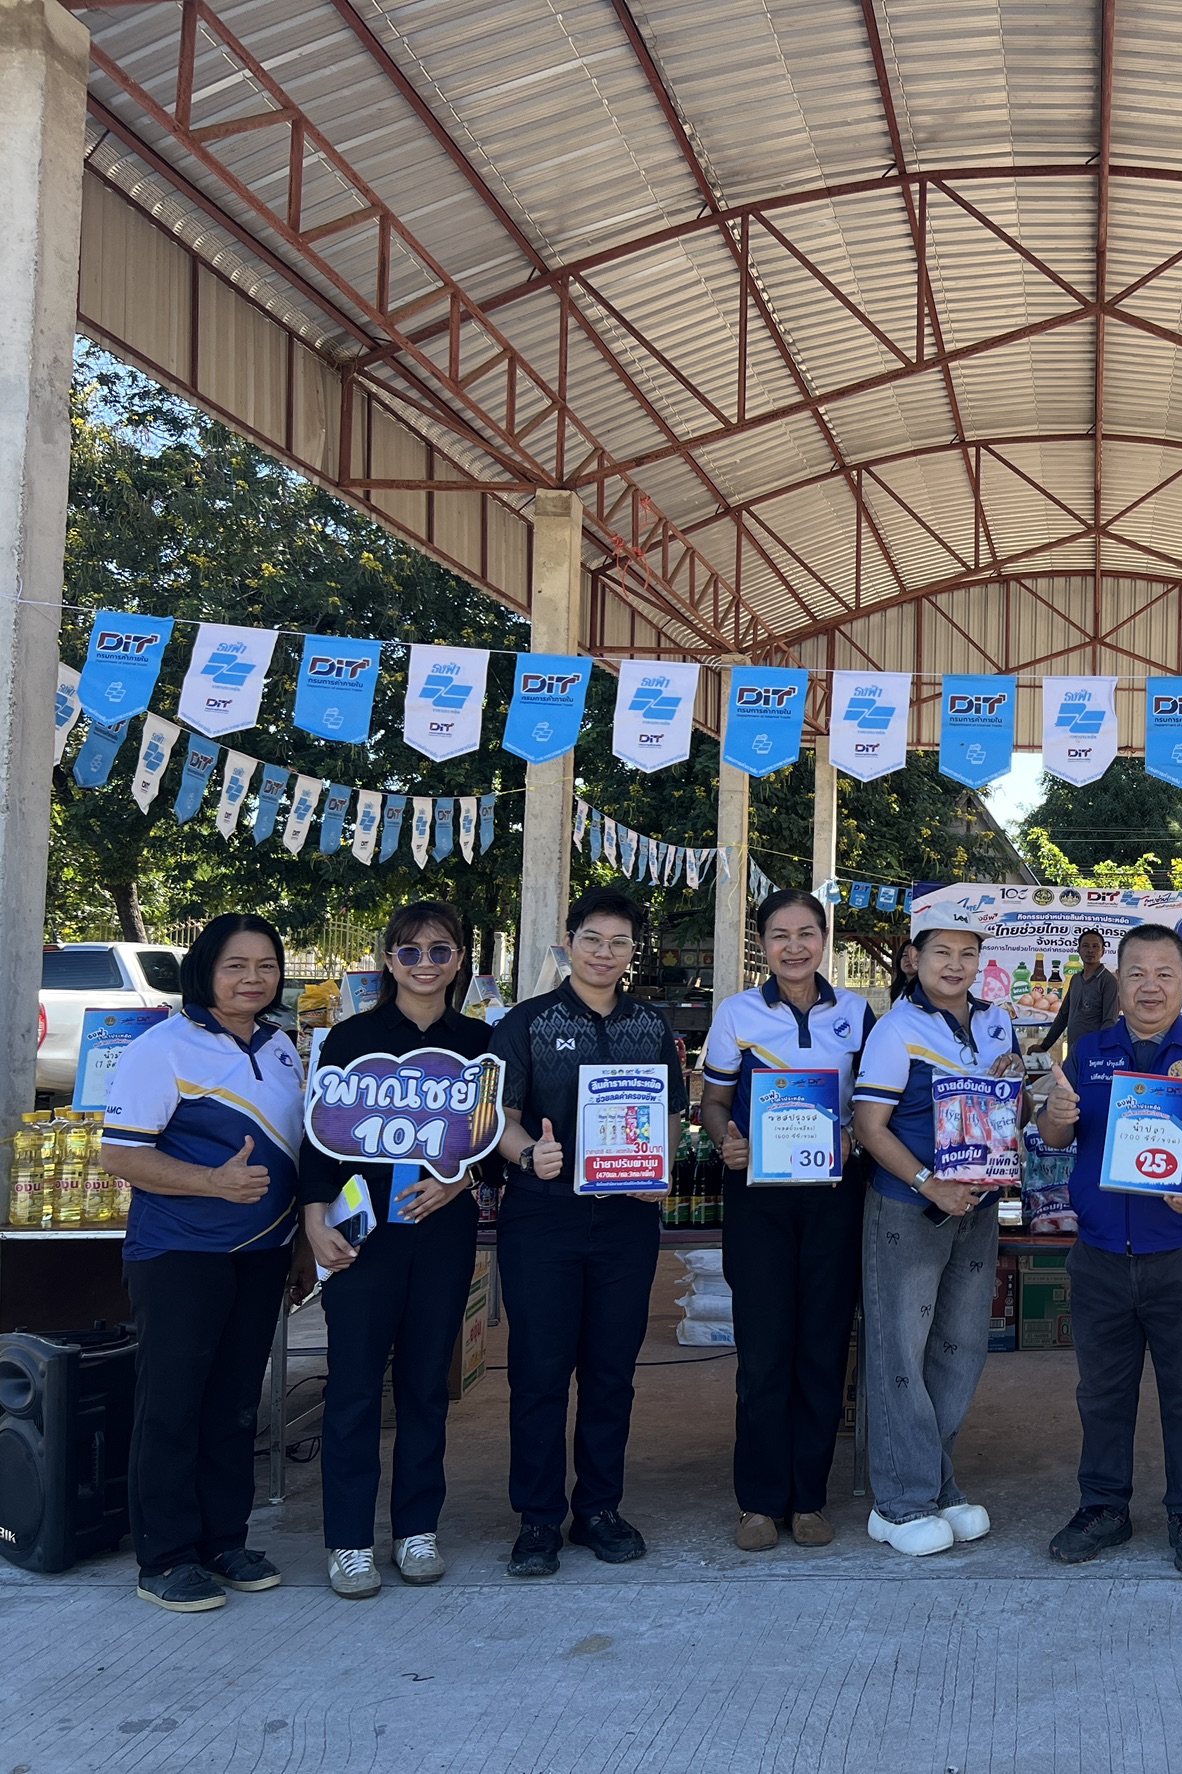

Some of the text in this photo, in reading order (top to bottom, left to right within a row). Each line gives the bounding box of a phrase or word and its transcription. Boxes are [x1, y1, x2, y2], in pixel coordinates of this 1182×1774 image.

[97, 631, 160, 654] DiT
[216, 641, 247, 653] ธงฟ้า
[96, 653, 149, 663] กรมการค้าภายใน
[308, 655, 371, 679] DiT
[432, 662, 461, 675] ธงฟ้า
[308, 678, 364, 689] กรมการค้าภายใน
[521, 672, 582, 695] DiT
[641, 676, 671, 687] ธงฟ้า
[736, 686, 798, 707] DiT
[854, 684, 882, 698] ธงฟ้า
[1064, 689, 1092, 702] ธงฟ้า
[206, 698, 233, 708] DiT
[521, 694, 574, 703] กรมการค้าภายใน
[949, 692, 1007, 715] DiT
[737, 707, 792, 715] กรมการค้าภายใน
[949, 715, 1003, 724] กรมการค้าภายใน
[429, 722, 455, 733] DiT
[639, 733, 664, 744] DiT
[854, 743, 880, 752] DiT
[1068, 748, 1092, 757] DiT
[1087, 891, 1120, 901] DiT
[1017, 912, 1130, 925] กิจกรรมจำหน่ายสินค้าราคาประหยัด
[322, 1065, 481, 1112] พาณิชย์
[591, 1078, 662, 1091] สินค้าราคาประหยัด
[937, 1079, 991, 1094] ขายดีอันดับ
[596, 1092, 657, 1103] ช่วยลดค่าครองชีพ
[1133, 1117, 1165, 1134] น้ำปลา
[353, 1115, 446, 1157] 101
[633, 1141, 649, 1154] 30
[799, 1149, 826, 1168] 30
[941, 1146, 982, 1164] หอมคุ้ม
[989, 1154, 1019, 1166] แพ็ค 3
[593, 1156, 659, 1169] น้ำยาปรับผ้านุ่ม
[85, 1178, 110, 1190] องุ่น
